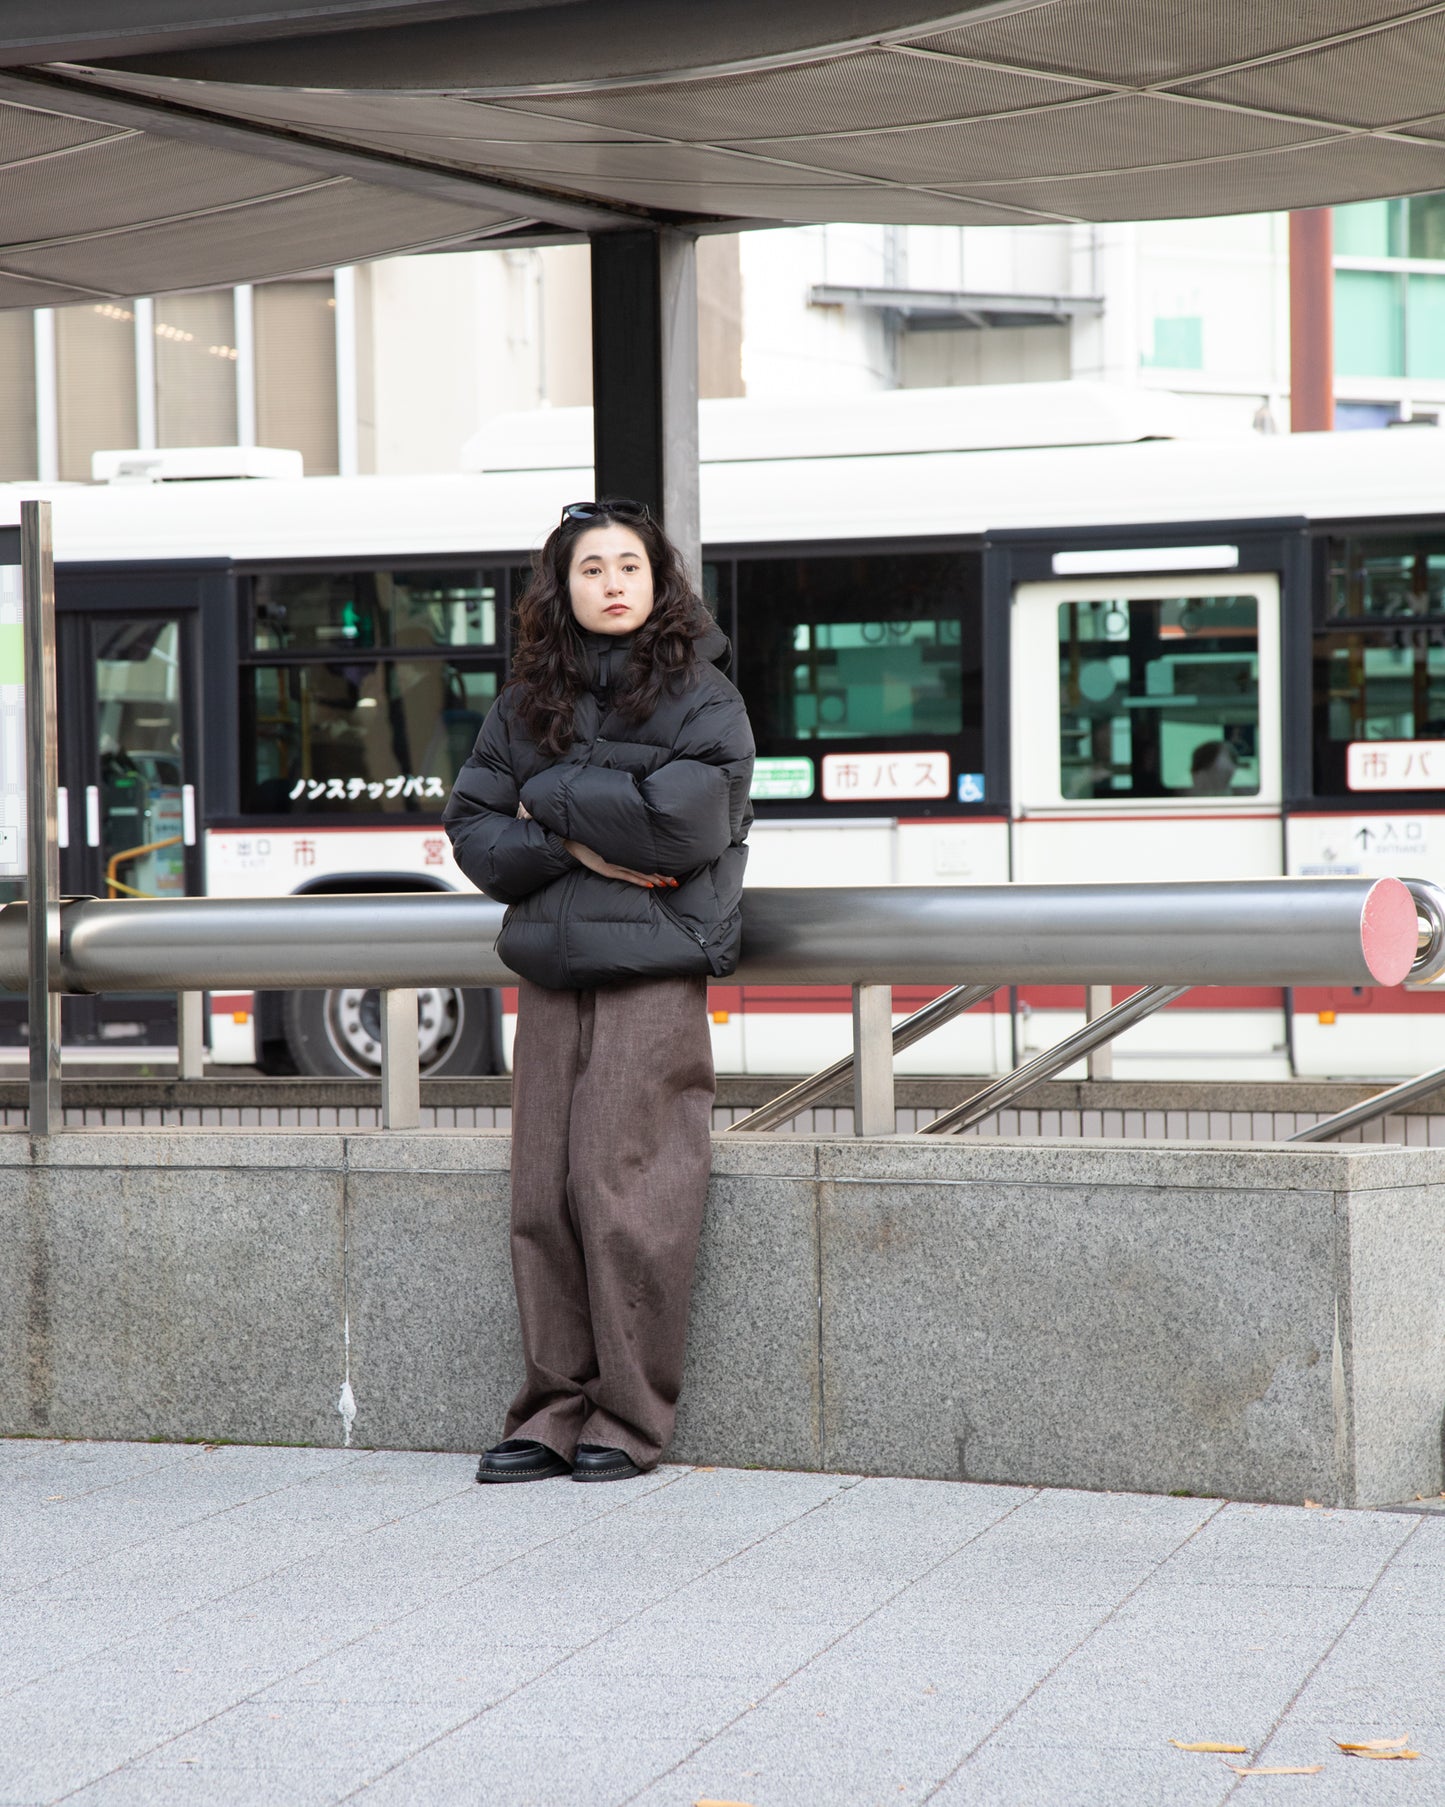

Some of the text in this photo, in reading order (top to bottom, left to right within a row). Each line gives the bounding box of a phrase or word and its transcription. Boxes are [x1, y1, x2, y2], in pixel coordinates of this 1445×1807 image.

[289, 775, 445, 800] ノンステップバス
[834, 762, 937, 789] 市バス
[1382, 821, 1422, 841] 入口
